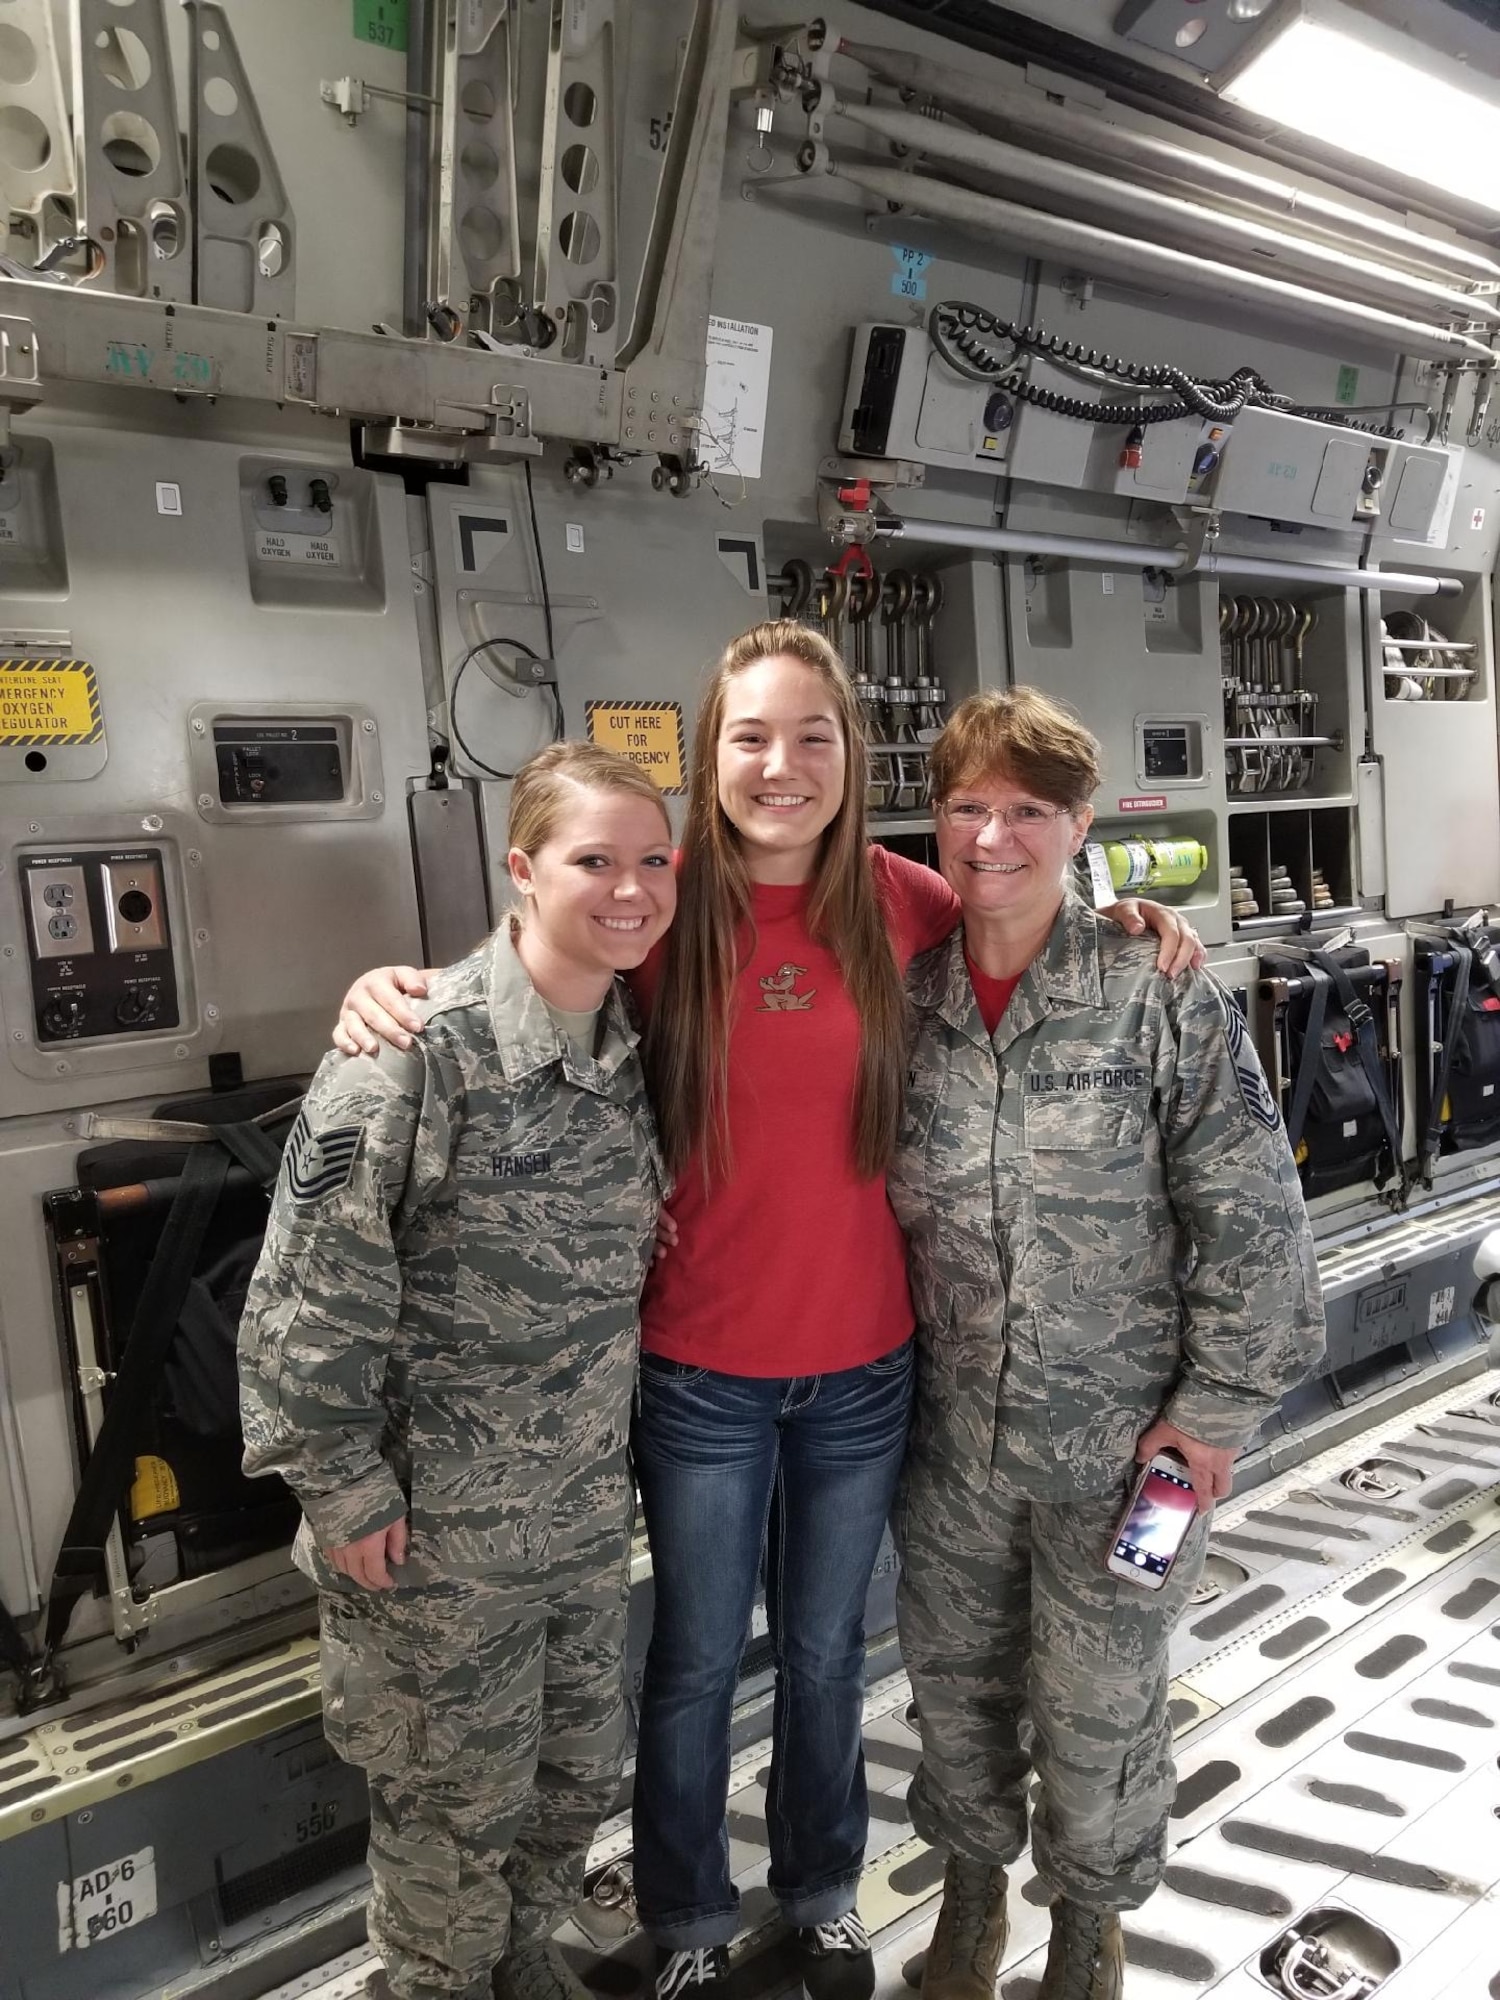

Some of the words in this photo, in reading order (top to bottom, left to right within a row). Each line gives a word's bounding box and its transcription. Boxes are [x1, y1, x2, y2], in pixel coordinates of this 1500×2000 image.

[368, 21, 394, 45] 537
[902, 248, 915, 263] PP
[917, 252, 924, 266] 2
[901, 280, 918, 296] 500
[717, 321, 759, 336] INSTALLATION
[266, 537, 285, 548] HALO
[310, 541, 328, 551] HALO
[261, 547, 291, 557] OXYGEN
[306, 552, 334, 561] OXYGEN
[0, 676, 37, 684] NTERLINE
[42, 676, 61, 684] SEAT
[0, 688, 65, 700] MERGENCY
[2, 702, 54, 715] OXYGEN
[1, 717, 69, 730] EGULATOR
[609, 717, 630, 729] CUT
[634, 717, 662, 729] HERE
[291, 729, 298, 741] 2
[627, 734, 648, 747] FOR
[617, 751, 670, 764] RGENCY
[1030, 1073, 1059, 1092] U.S.
[1093, 1068, 1144, 1089] FORCE
[492, 1152, 552, 1177] HANSEN
[88, 1900, 133, 1939] 560
